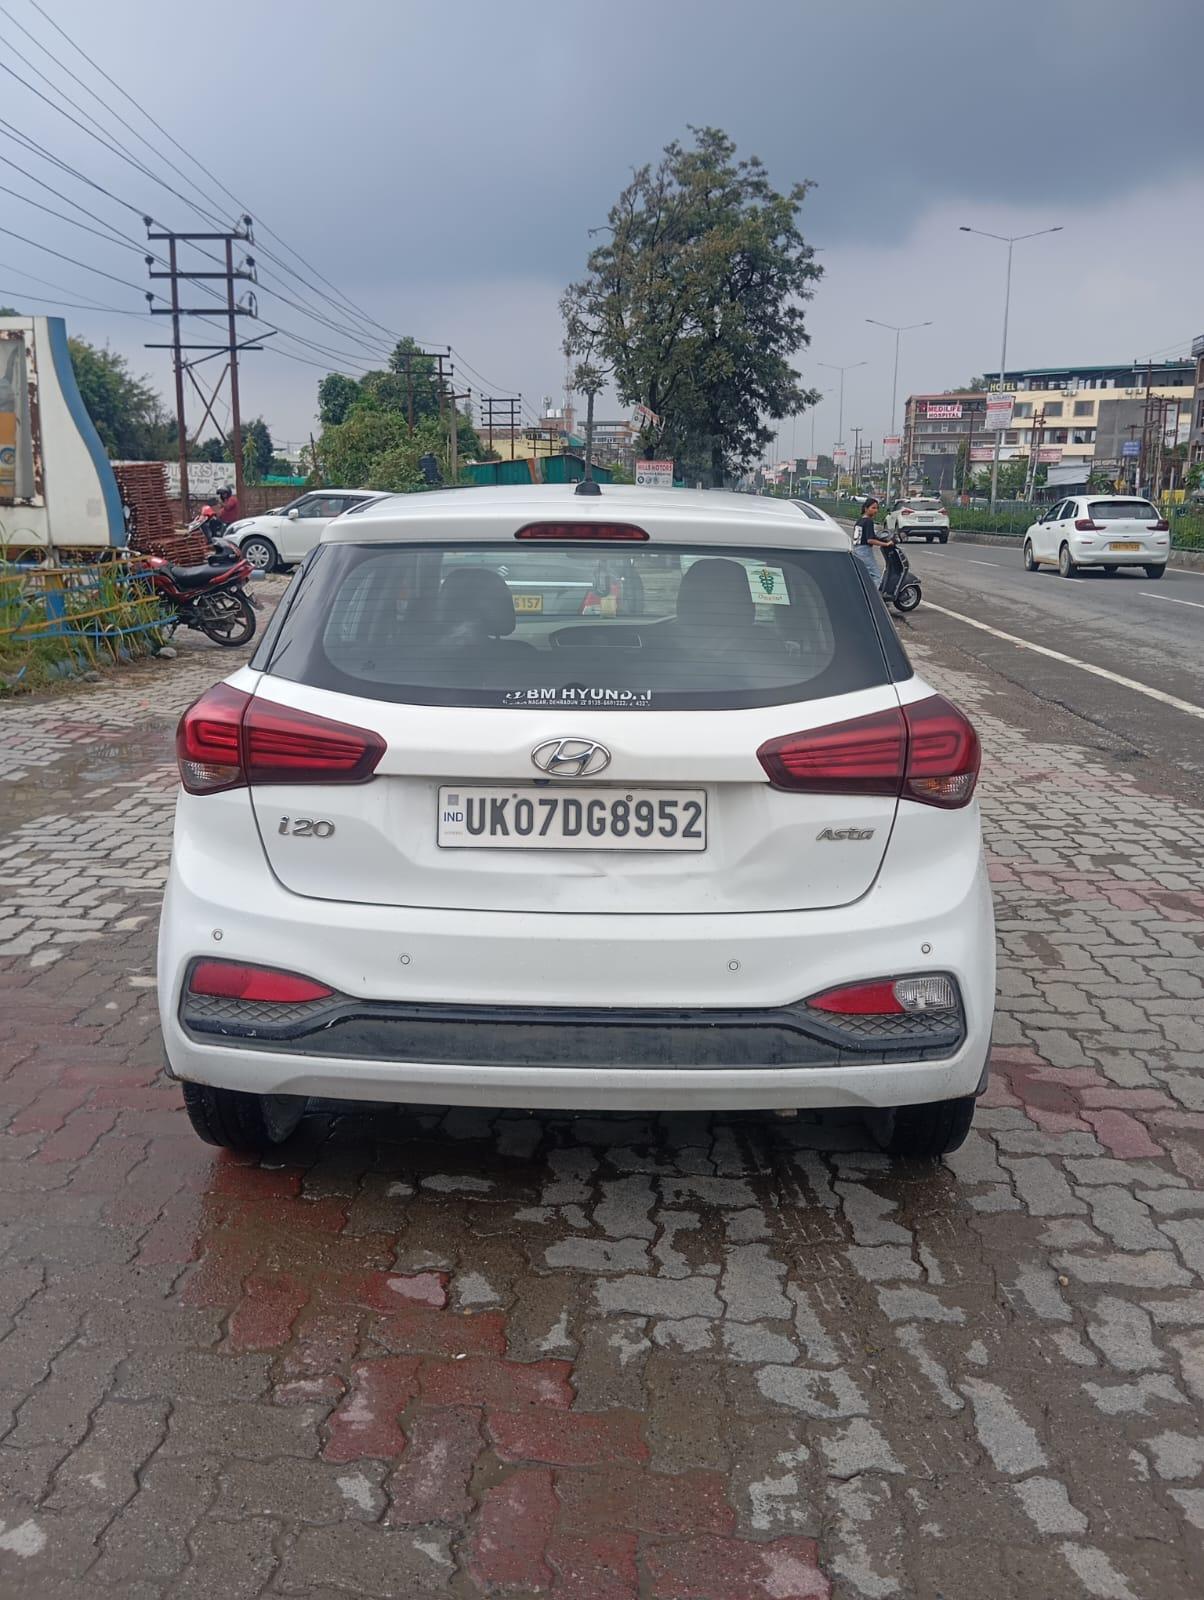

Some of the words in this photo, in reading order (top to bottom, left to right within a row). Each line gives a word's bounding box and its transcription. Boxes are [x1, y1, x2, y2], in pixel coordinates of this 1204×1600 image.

[990, 383, 1015, 392] HOTEL
[527, 688, 556, 699] BM
[443, 811, 464, 822] IND
[466, 797, 702, 838] UK07DG8952
[278, 815, 335, 837] i20
